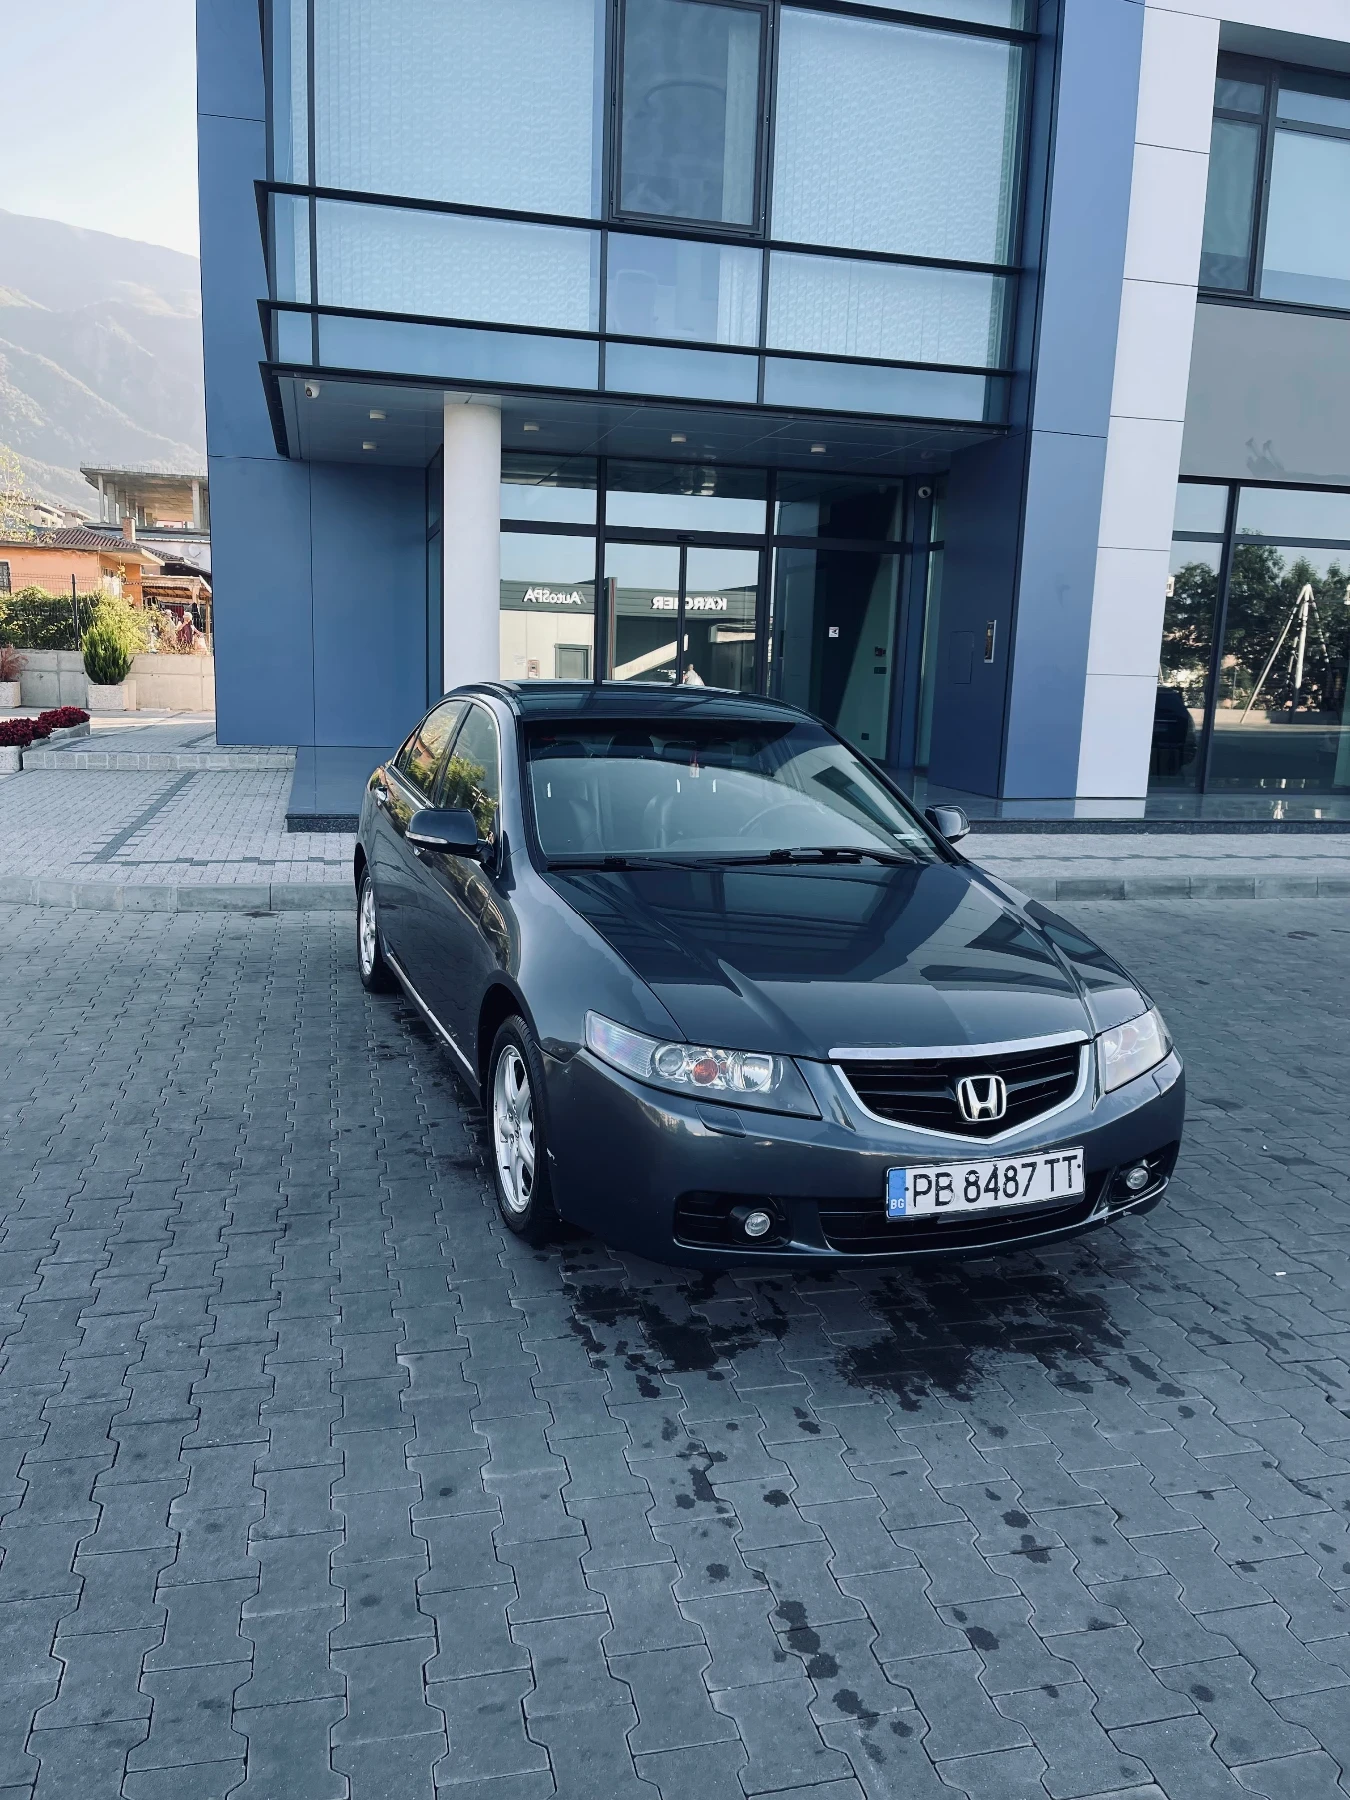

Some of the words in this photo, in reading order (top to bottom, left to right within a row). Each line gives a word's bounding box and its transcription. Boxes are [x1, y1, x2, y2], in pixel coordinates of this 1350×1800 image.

[913, 1172, 954, 1208] PB
[964, 1162, 1037, 1203] 8487
[1044, 1155, 1078, 1192] TT
[890, 1198, 905, 1210] BG
